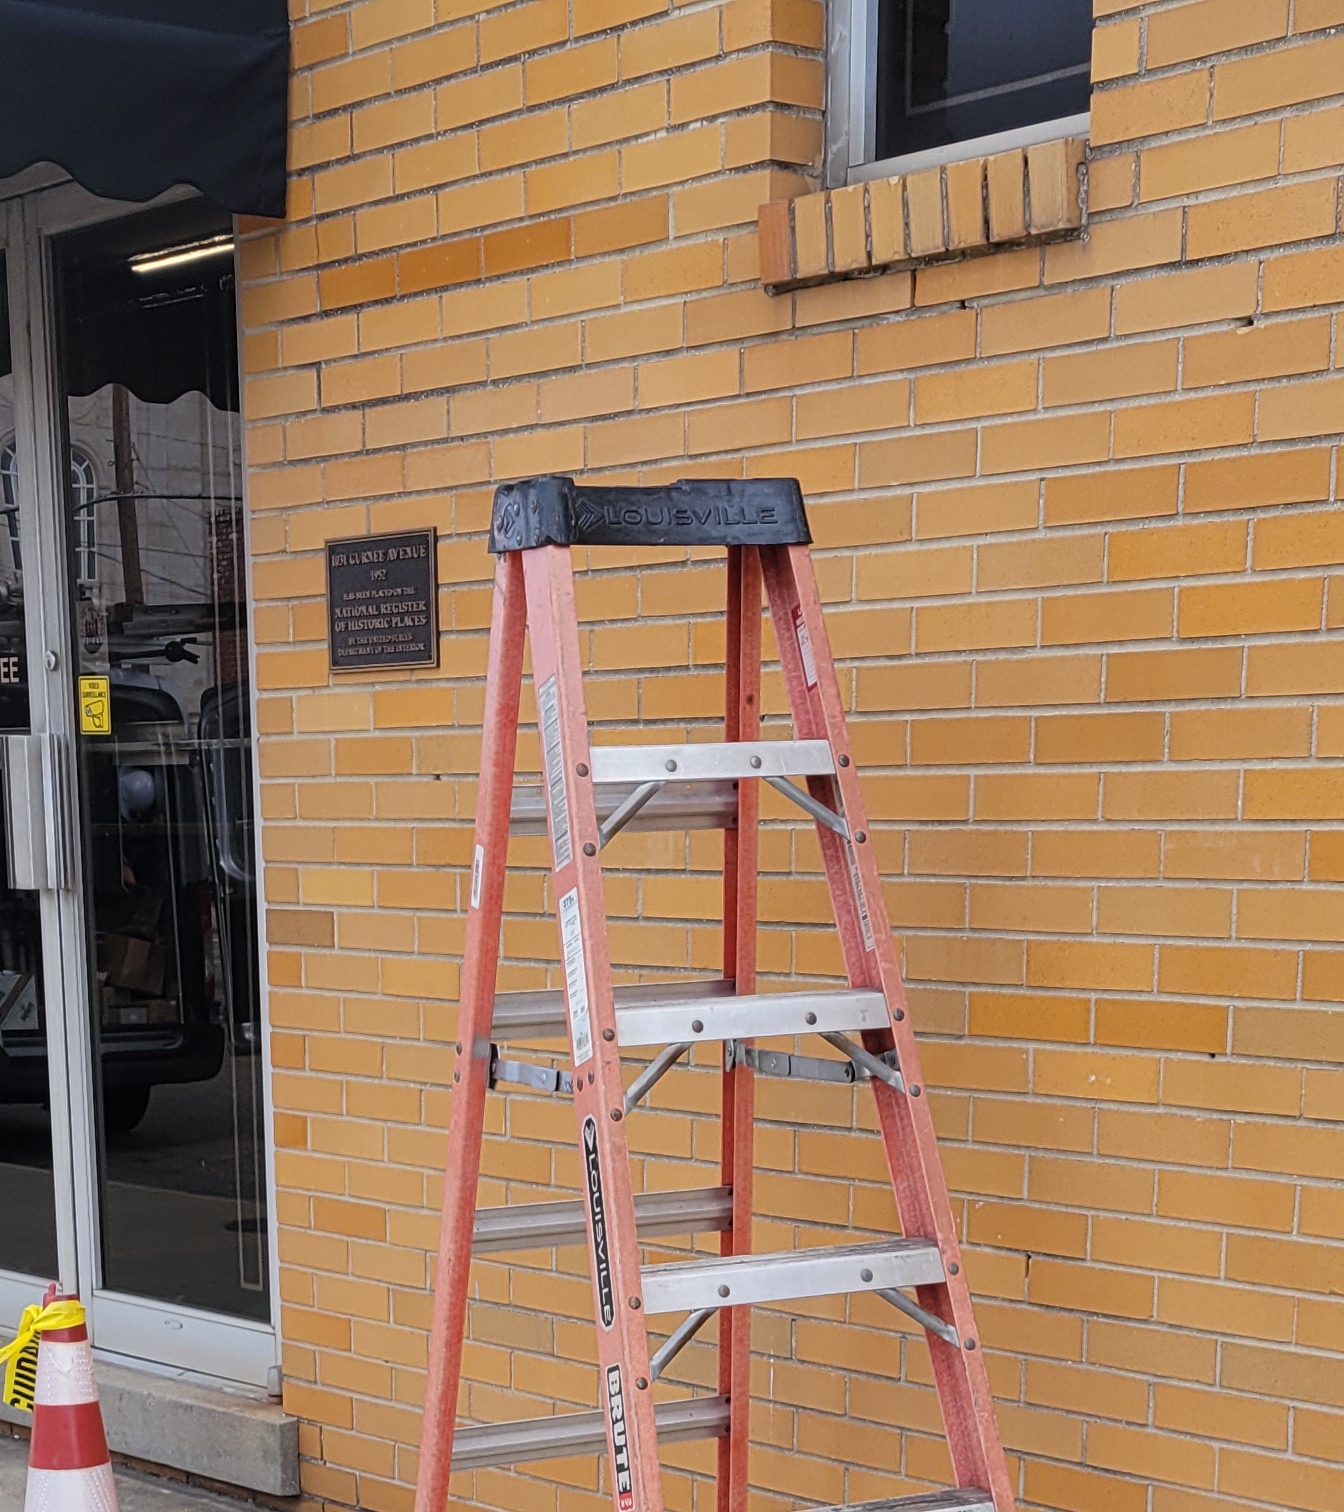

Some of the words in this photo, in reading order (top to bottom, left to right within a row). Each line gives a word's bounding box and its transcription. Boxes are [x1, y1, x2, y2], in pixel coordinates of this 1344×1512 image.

[606, 505, 779, 526] LOUISVILLE
[349, 549, 386, 565] GURNEE
[387, 545, 427, 561] AVENUE
[335, 604, 379, 619] NATIONAL
[380, 600, 427, 615] REGISTER
[334, 621, 347, 632] OF
[348, 617, 390, 631] HISTORIC
[391, 615, 427, 628] PLACES
[587, 1152, 613, 1326] LOUISVILLE
[608, 1369, 631, 1493] BRUTE
